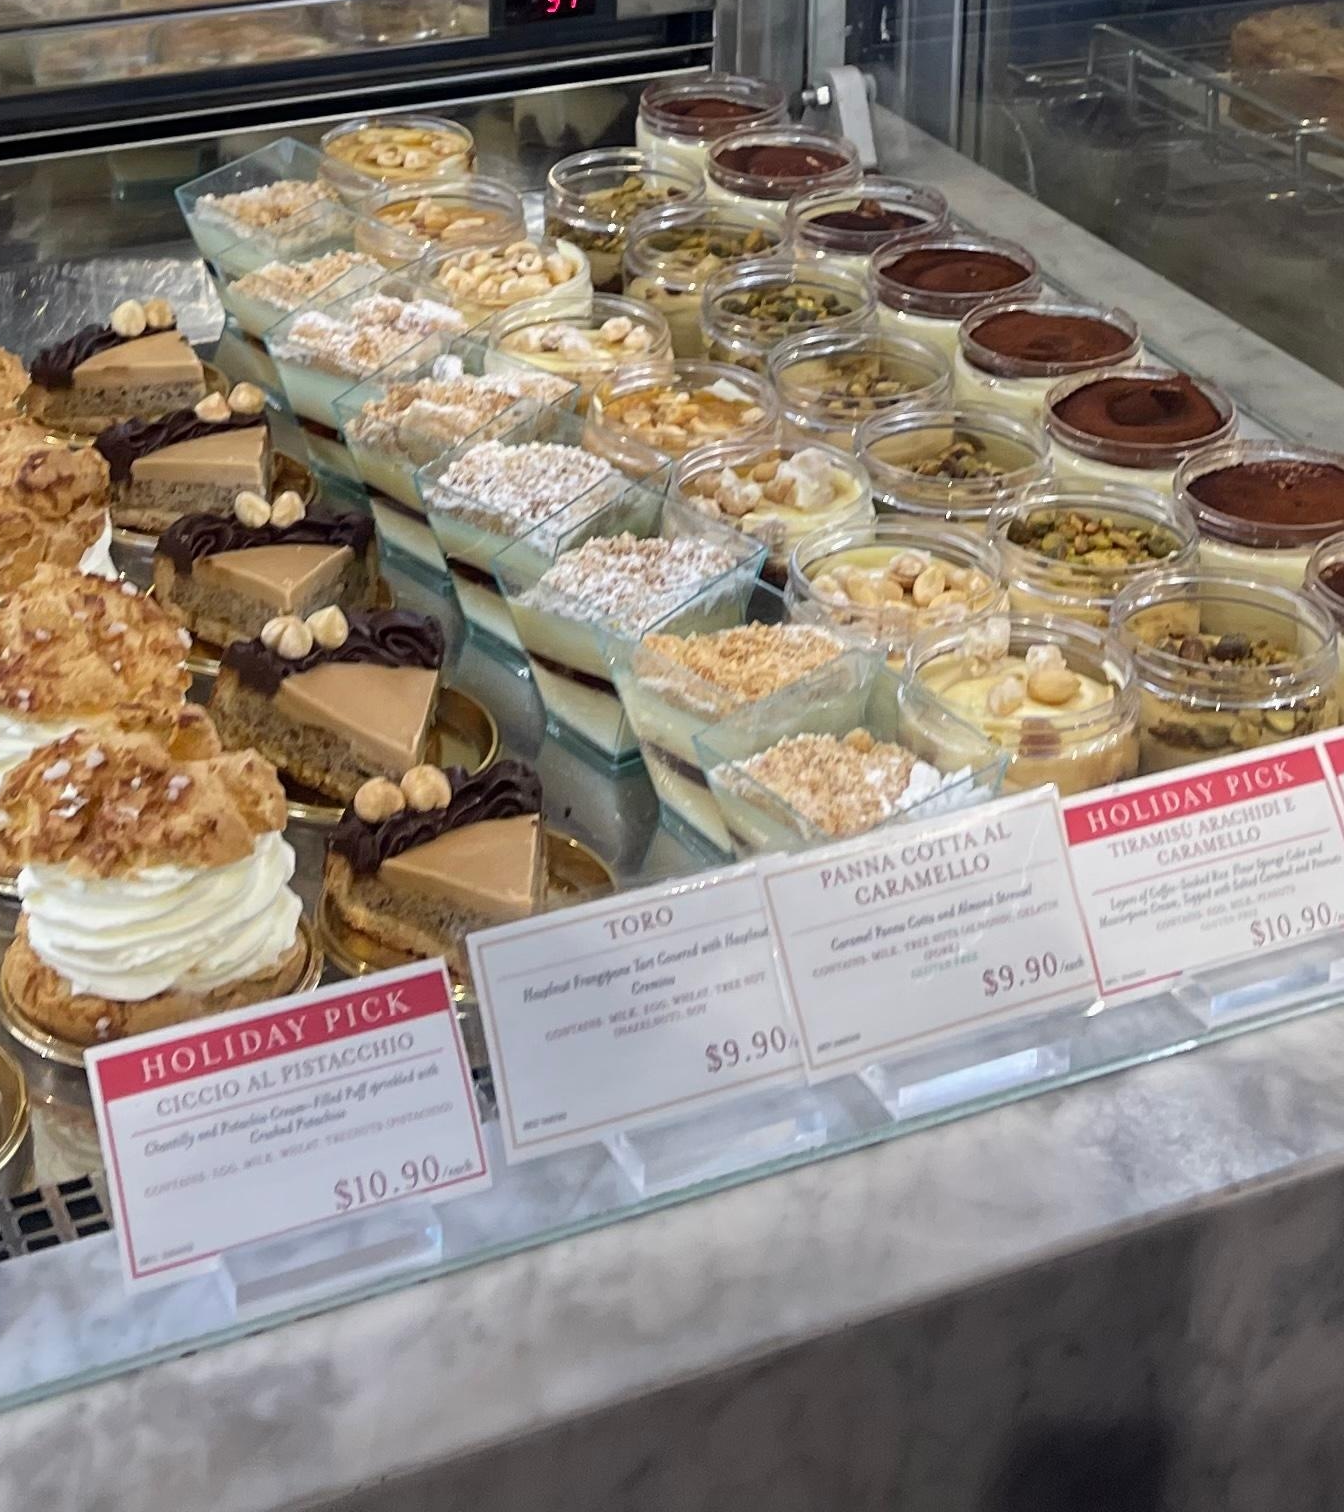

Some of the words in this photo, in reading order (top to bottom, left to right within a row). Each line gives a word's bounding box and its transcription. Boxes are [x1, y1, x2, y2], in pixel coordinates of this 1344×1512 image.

[1084, 780, 1218, 834] HOLIDAY
[1224, 760, 1296, 797] PICK
[1195, 798, 1282, 835] ARACHIDI
[819, 850, 895, 891] PANNA
[899, 828, 977, 869] COTTA
[980, 819, 1012, 845] AL
[1155, 825, 1263, 866] CARAMELLO
[853, 850, 992, 908] CARAMELLO
[602, 904, 675, 942] TORO
[1247, 899, 1334, 947] $10.90
[980, 950, 1059, 998] $9.90
[139, 1014, 311, 1083] HOLIDAY
[322, 987, 412, 1035] PICK
[702, 1023, 789, 1075] $9.90
[153, 1077, 241, 1118] CICCIO
[244, 1068, 275, 1093] AL
[278, 1030, 415, 1084] PISTACCHIO
[331, 1153, 442, 1210] $10.90
